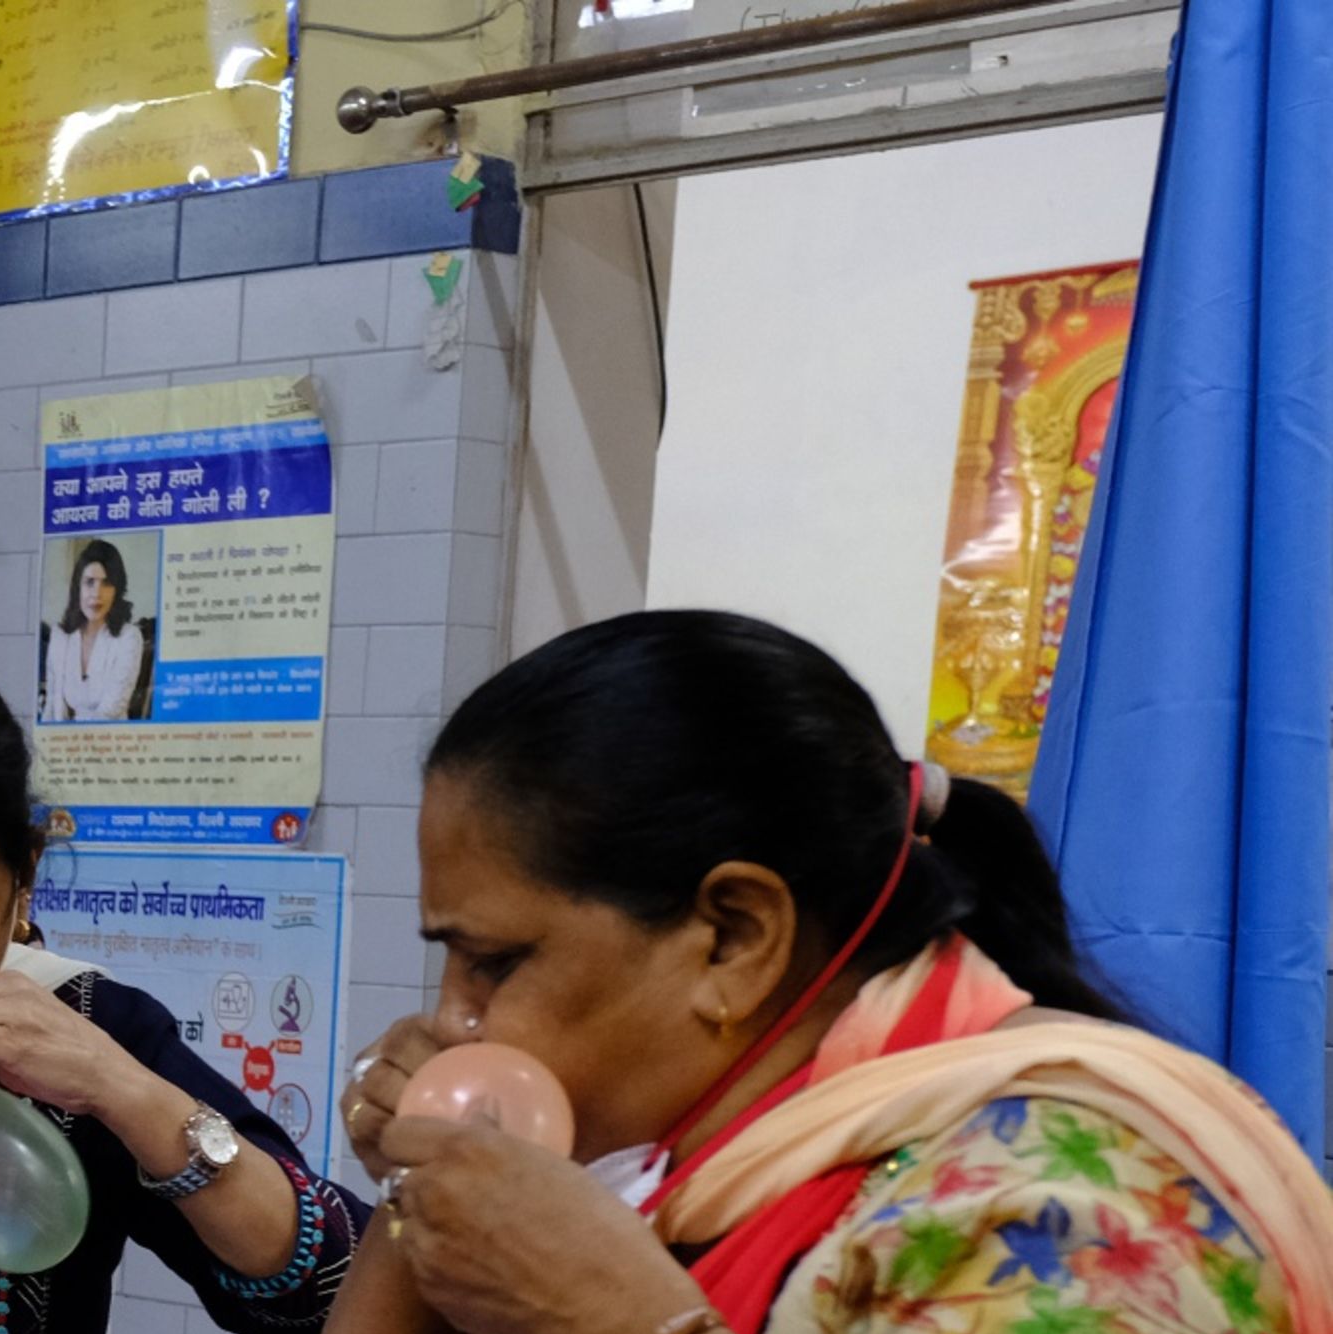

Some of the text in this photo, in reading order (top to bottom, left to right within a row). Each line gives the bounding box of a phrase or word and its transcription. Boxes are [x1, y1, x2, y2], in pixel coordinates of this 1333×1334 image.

[53, 478, 80, 497] क्या
[86, 468, 128, 495] आपने
[136, 471, 162, 495] इस
[51, 487, 271, 525] आयरन की नीली गोली ली ?
[74, 888, 116, 925] मातृत्व
[119, 881, 138, 914] को
[190, 884, 265, 921] प्राथमिकता
